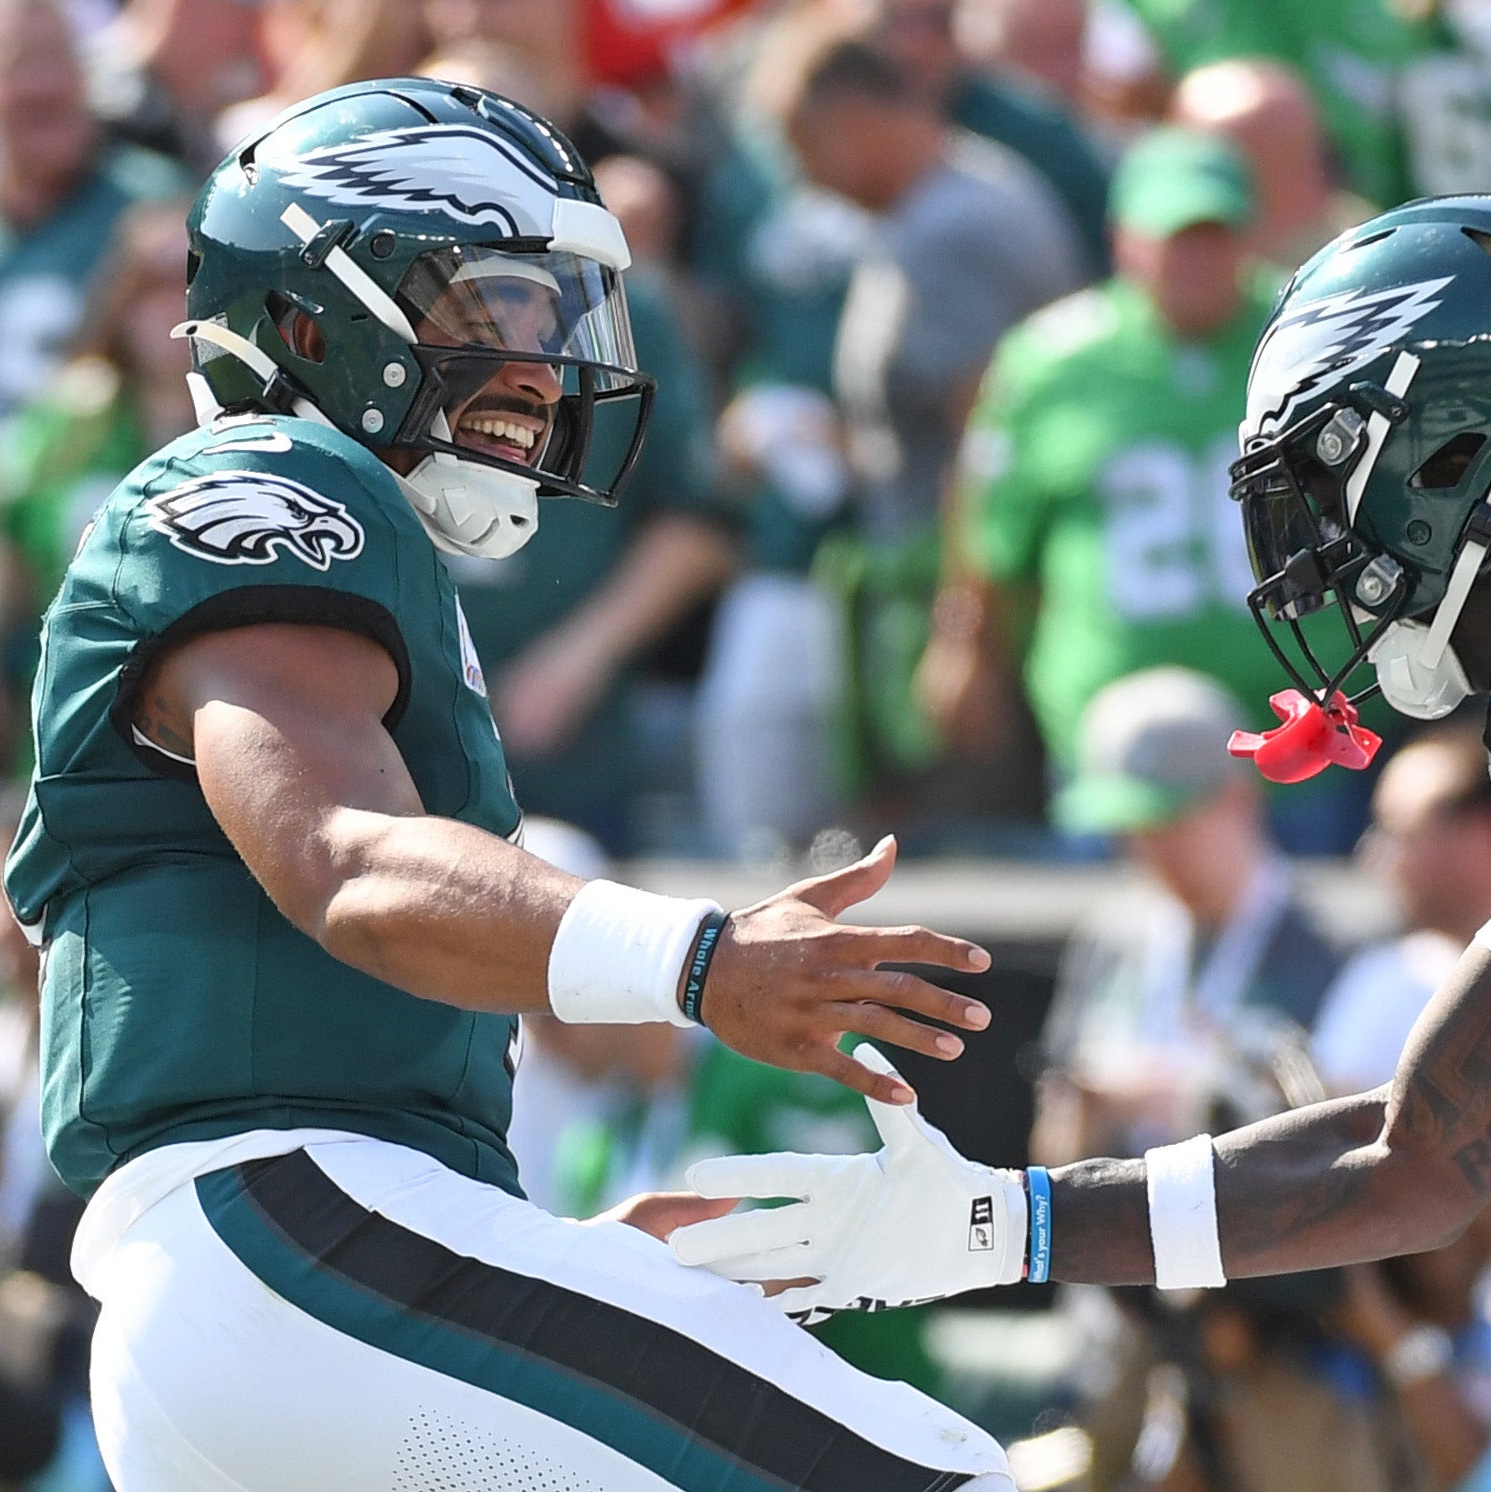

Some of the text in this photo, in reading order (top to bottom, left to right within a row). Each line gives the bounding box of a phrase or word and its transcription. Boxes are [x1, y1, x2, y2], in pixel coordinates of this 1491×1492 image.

[692, 928, 718, 976] Whole
[1035, 1195, 1049, 1226] Why?
[1037, 1227, 1048, 1252] your
